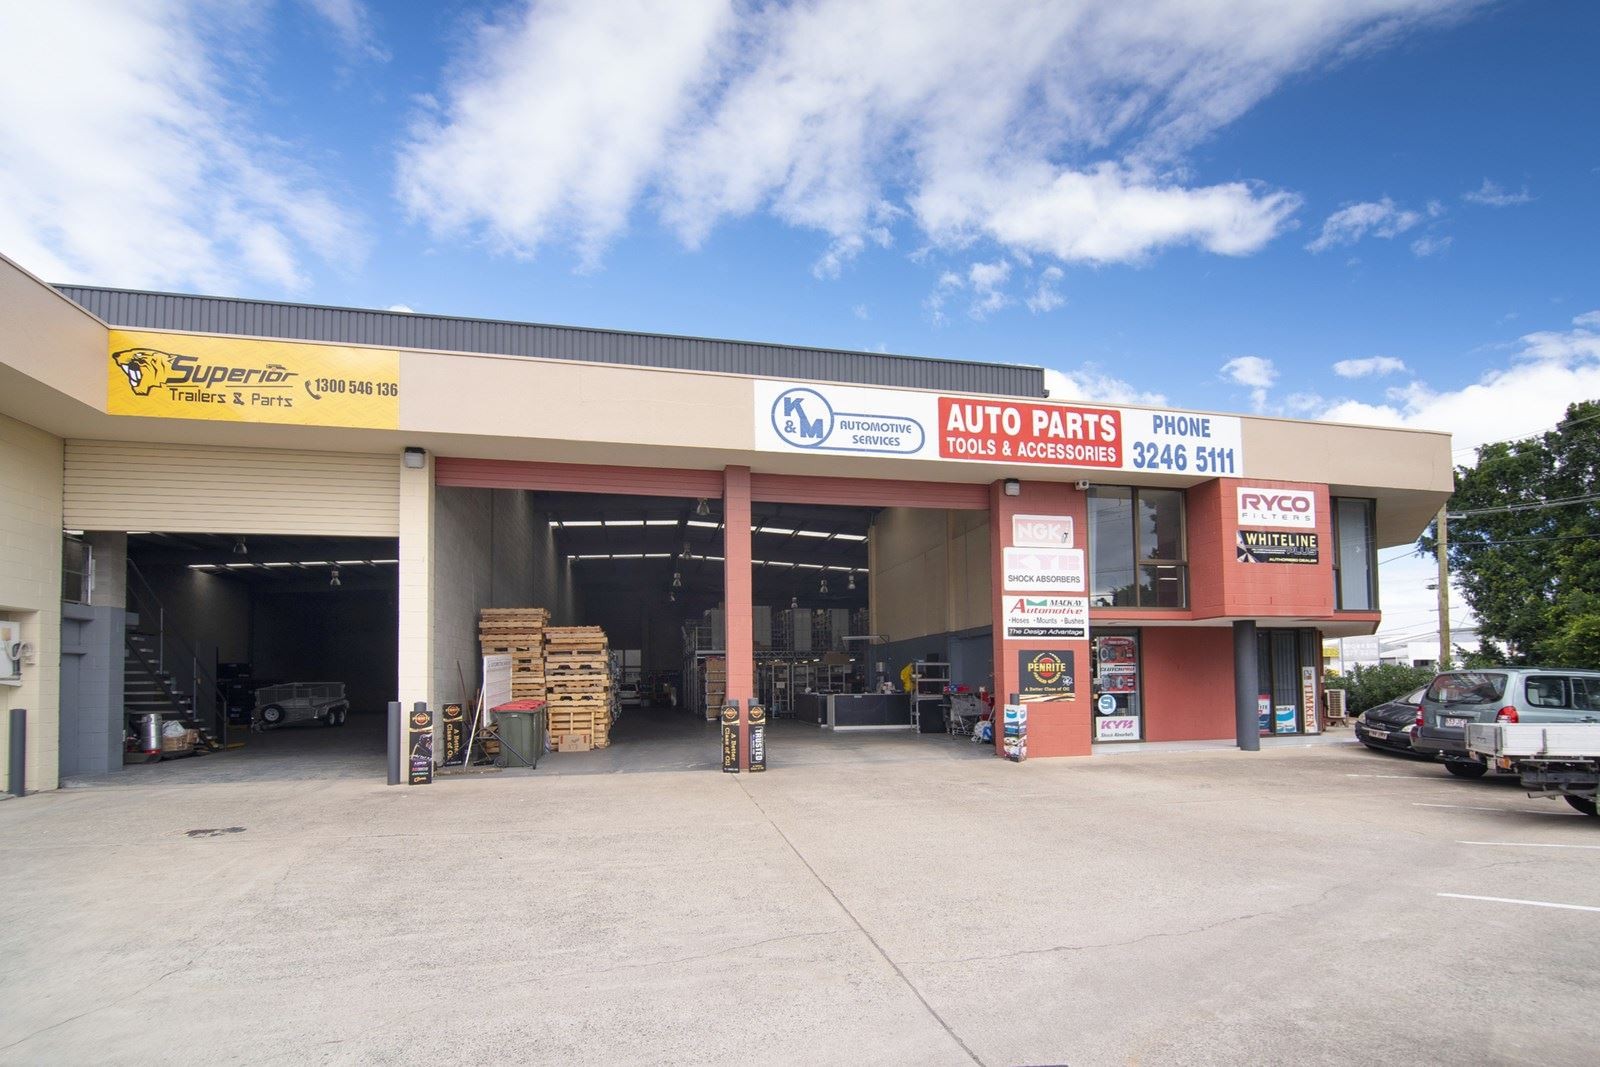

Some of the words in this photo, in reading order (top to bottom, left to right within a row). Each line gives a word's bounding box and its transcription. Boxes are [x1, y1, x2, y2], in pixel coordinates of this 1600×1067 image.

[167, 355, 298, 388] Superior
[315, 378, 345, 393] 1300
[349, 379, 373, 395] 546
[376, 382, 398, 397] 136
[170, 388, 226, 404] Trailers
[233, 392, 245, 405] &
[252, 393, 293, 407] Parts
[840, 420, 912, 434] AUTOMOTIVE
[946, 403, 1022, 436] AUTO
[1032, 409, 1117, 442] PARTS
[1152, 414, 1211, 438] PHONE
[852, 434, 901, 447] SERVICES
[946, 436, 997, 456] TOOLS
[1002, 440, 1012, 456] &
[1017, 441, 1117, 463] ACCESSORIES
[1132, 441, 1187, 471] 3246
[1196, 446, 1235, 473] 5111
[1241, 493, 1311, 513] RYCO
[1241, 512, 1311, 521] FILTERS
[1246, 532, 1317, 547] WHITELINE
[1008, 574, 1035, 583] SHOCK
[1036, 575, 1081, 584] ABSORBERS
[1010, 598, 1082, 615] Automotive
[1023, 628, 1047, 636] Design
[1027, 662, 1066, 672] PENRITE
[1304, 683, 1315, 728] TIMKEN
[755, 728, 763, 761] TRUSTED
